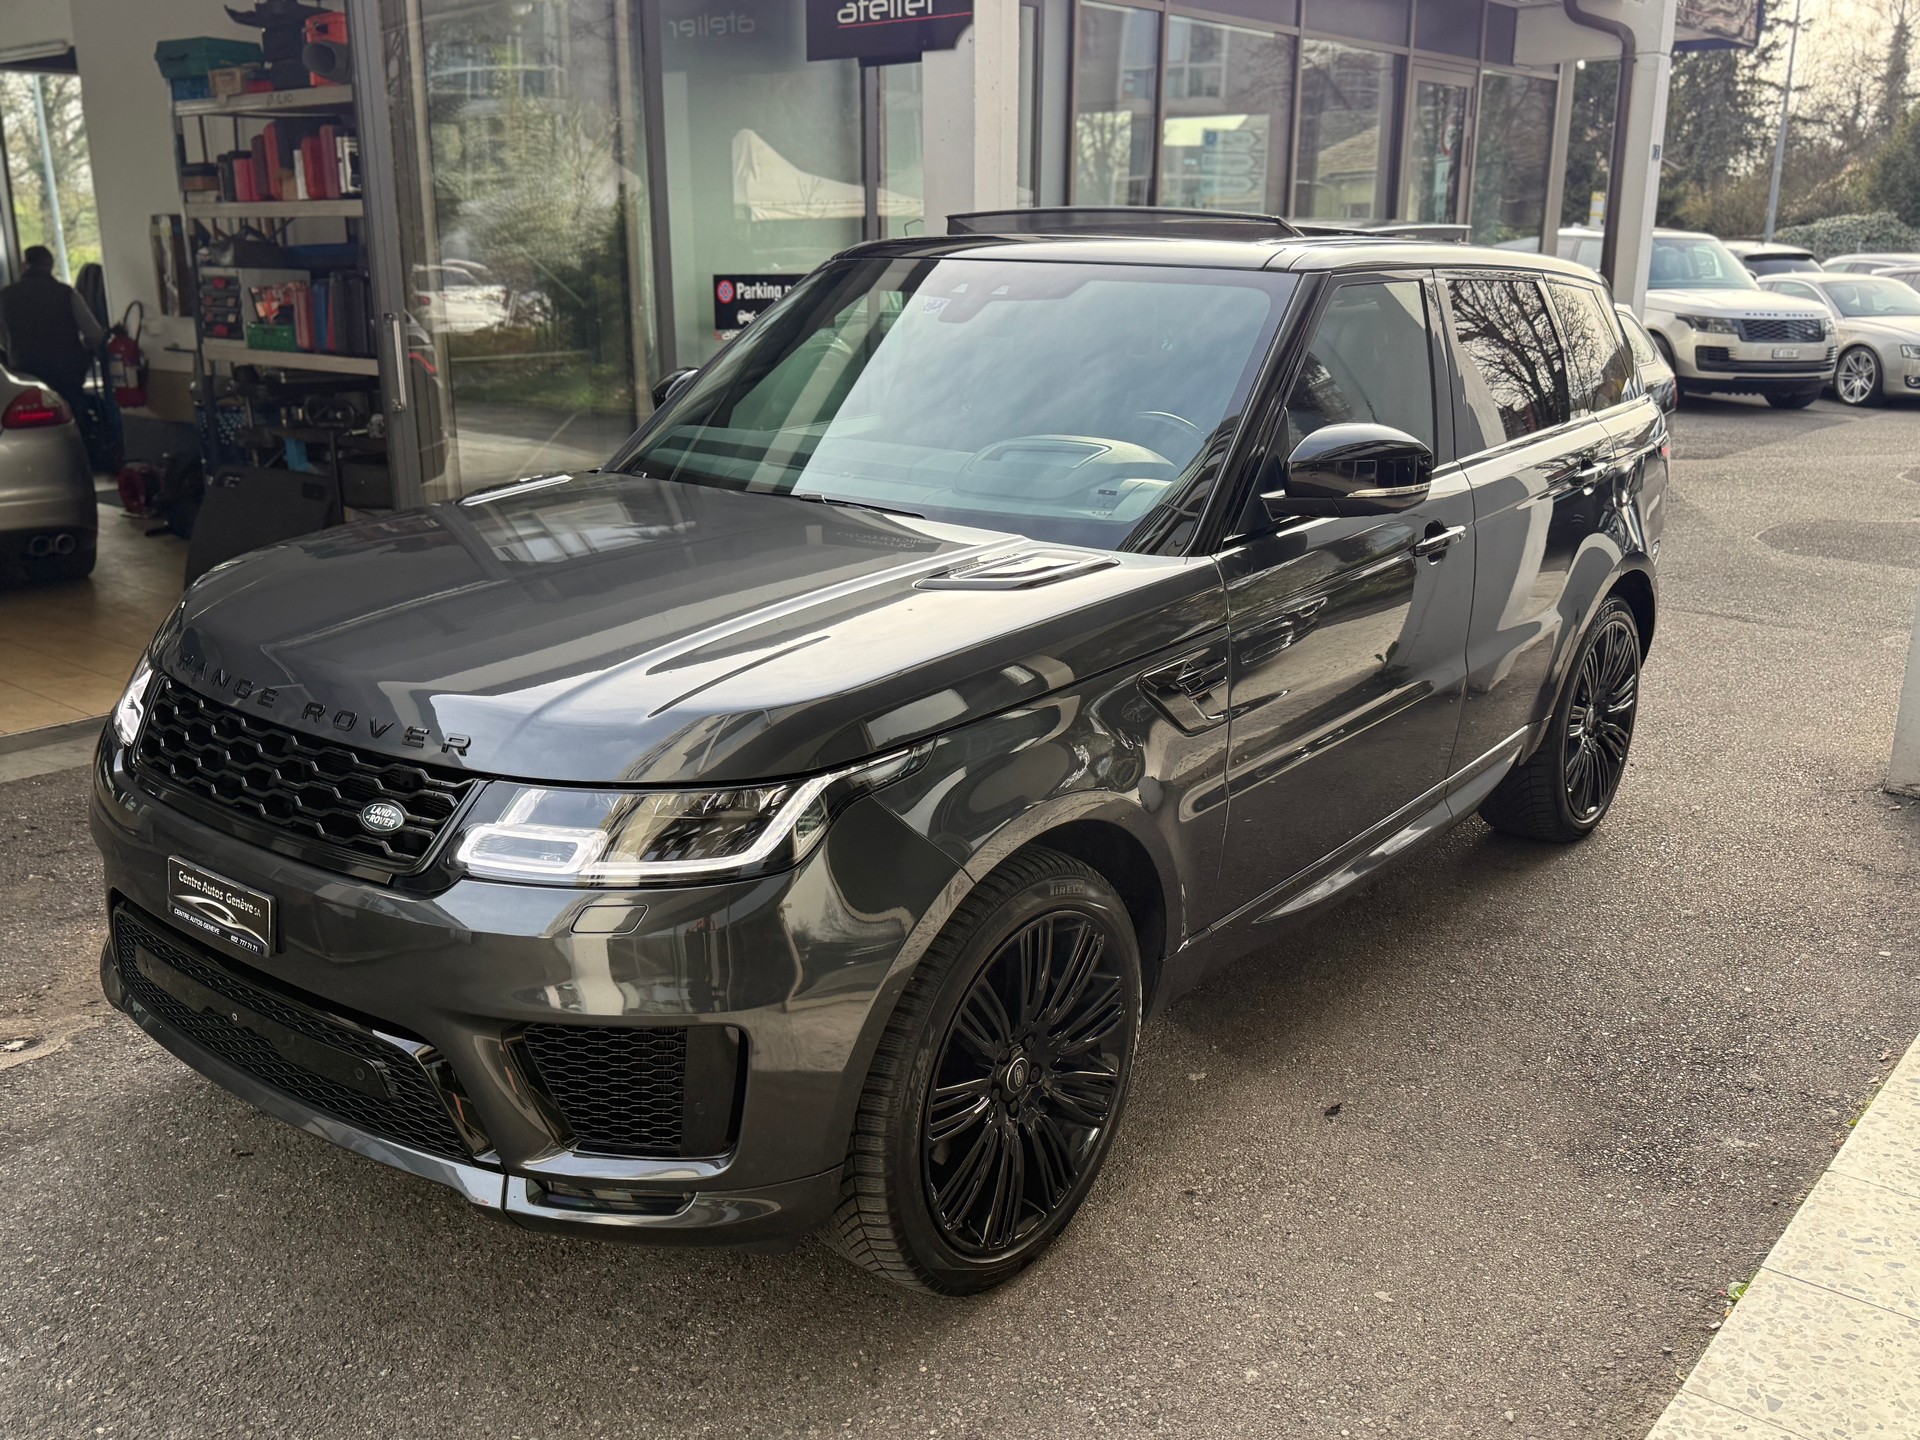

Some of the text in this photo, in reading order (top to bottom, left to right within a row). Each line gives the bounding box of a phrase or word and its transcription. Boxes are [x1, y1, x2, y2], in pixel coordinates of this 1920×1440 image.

[736, 282, 782, 302] Parking
[176, 655, 472, 757] RANGE ROVER
[370, 805, 393, 817] LAND
[369, 814, 395, 828] ROVER
[178, 870, 202, 891] Centre
[202, 881, 224, 900] Autos
[226, 892, 254, 914] Genève
[174, 907, 190, 921] CENTRE
